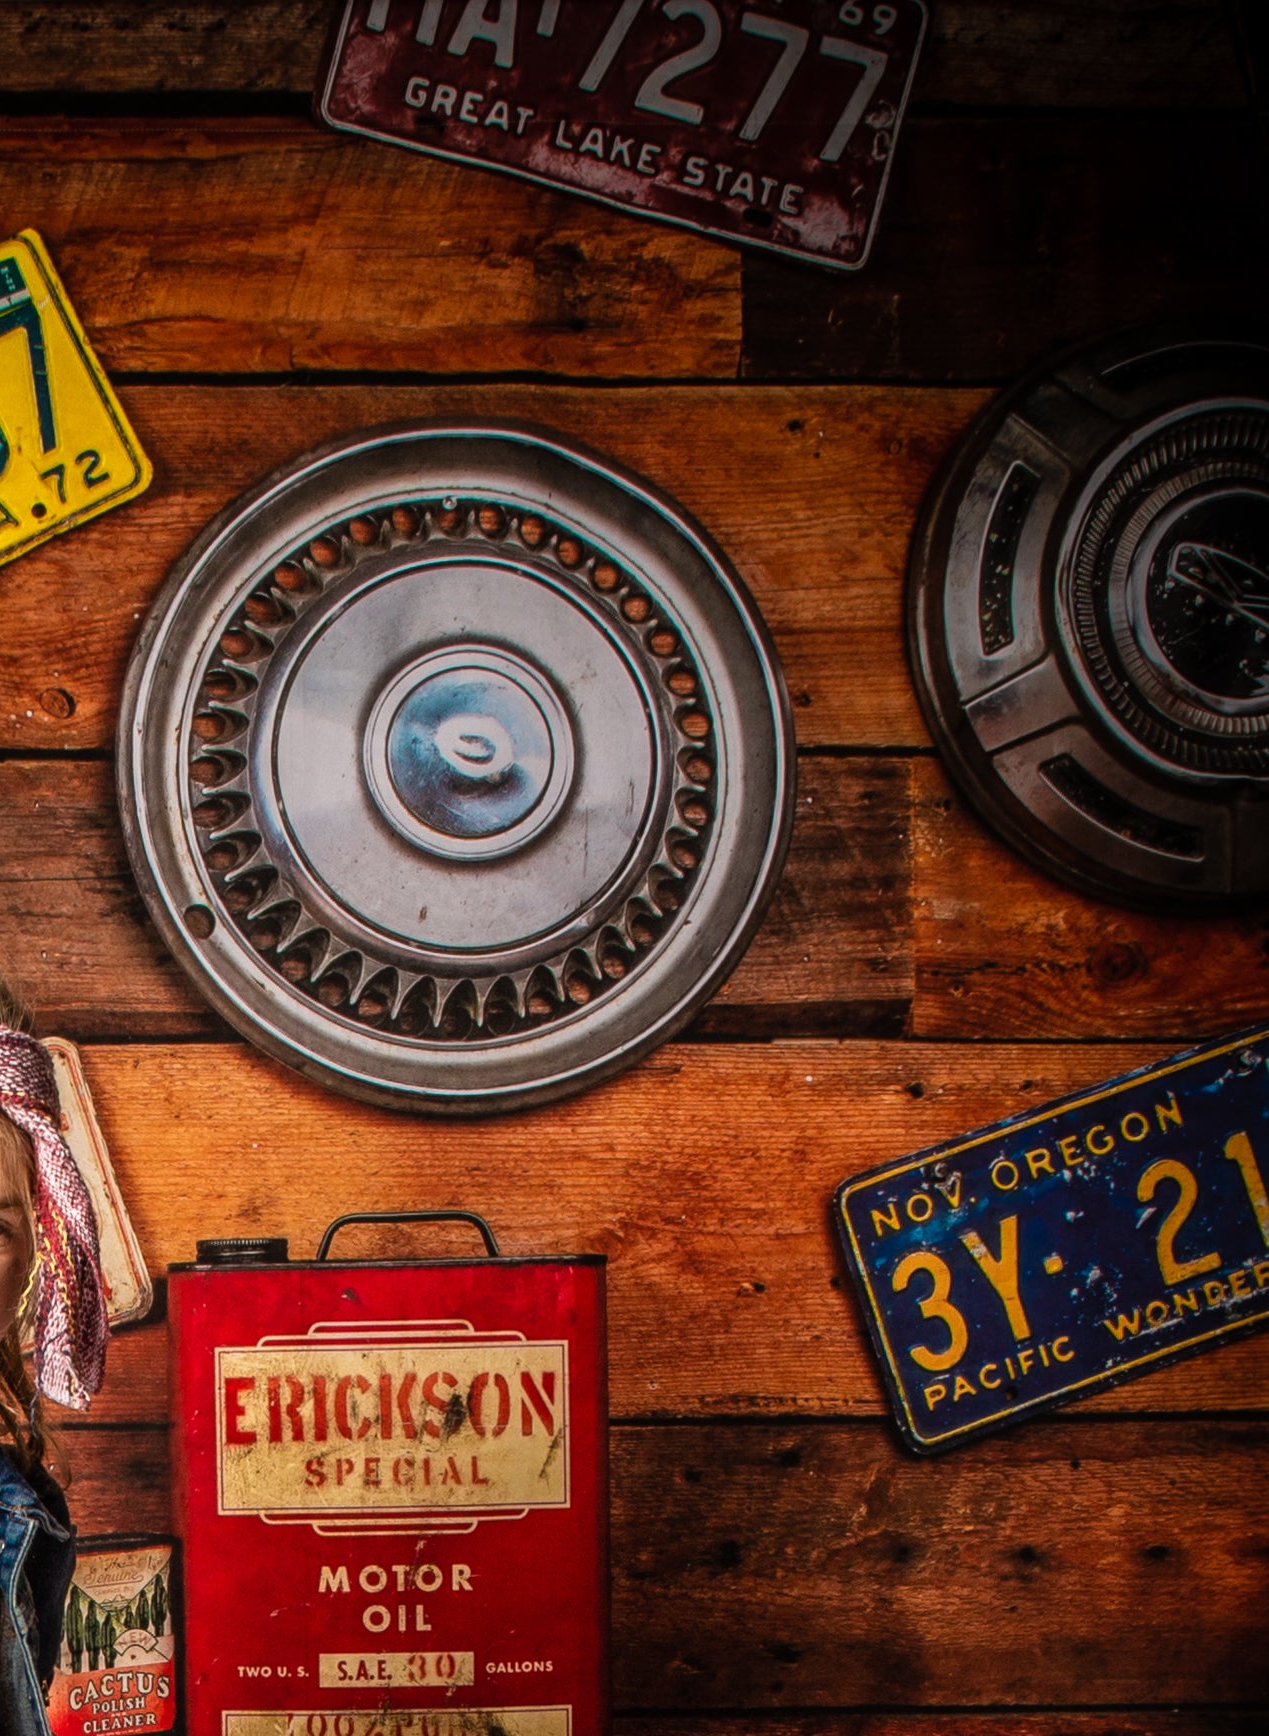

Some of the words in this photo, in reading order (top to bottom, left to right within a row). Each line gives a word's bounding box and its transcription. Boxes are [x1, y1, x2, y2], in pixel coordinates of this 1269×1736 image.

[404, 77, 534, 136] GREAT
[556, 119, 663, 176] LAKE
[684, 157, 804, 215] STATE
[40, 448, 111, 505] 72
[991, 1090, 1185, 1191] OREGON
[923, 1335, 1075, 1411] PACIFIC
[223, 1371, 556, 1446] ERICKSON
[303, 1456, 489, 1488] SPECIAL
[318, 1564, 474, 1593] MOTOR
[362, 1604, 432, 1632] OIL
[237, 1666, 273, 1679] TWO
[337, 1658, 393, 1682] S.A.E.
[408, 1652, 457, 1682] 30
[485, 1660, 554, 1674] GALLONS
[69, 1671, 170, 1710] CACTUS
[92, 1696, 147, 1714] POLISH
[83, 1714, 157, 1734] CLEANER
